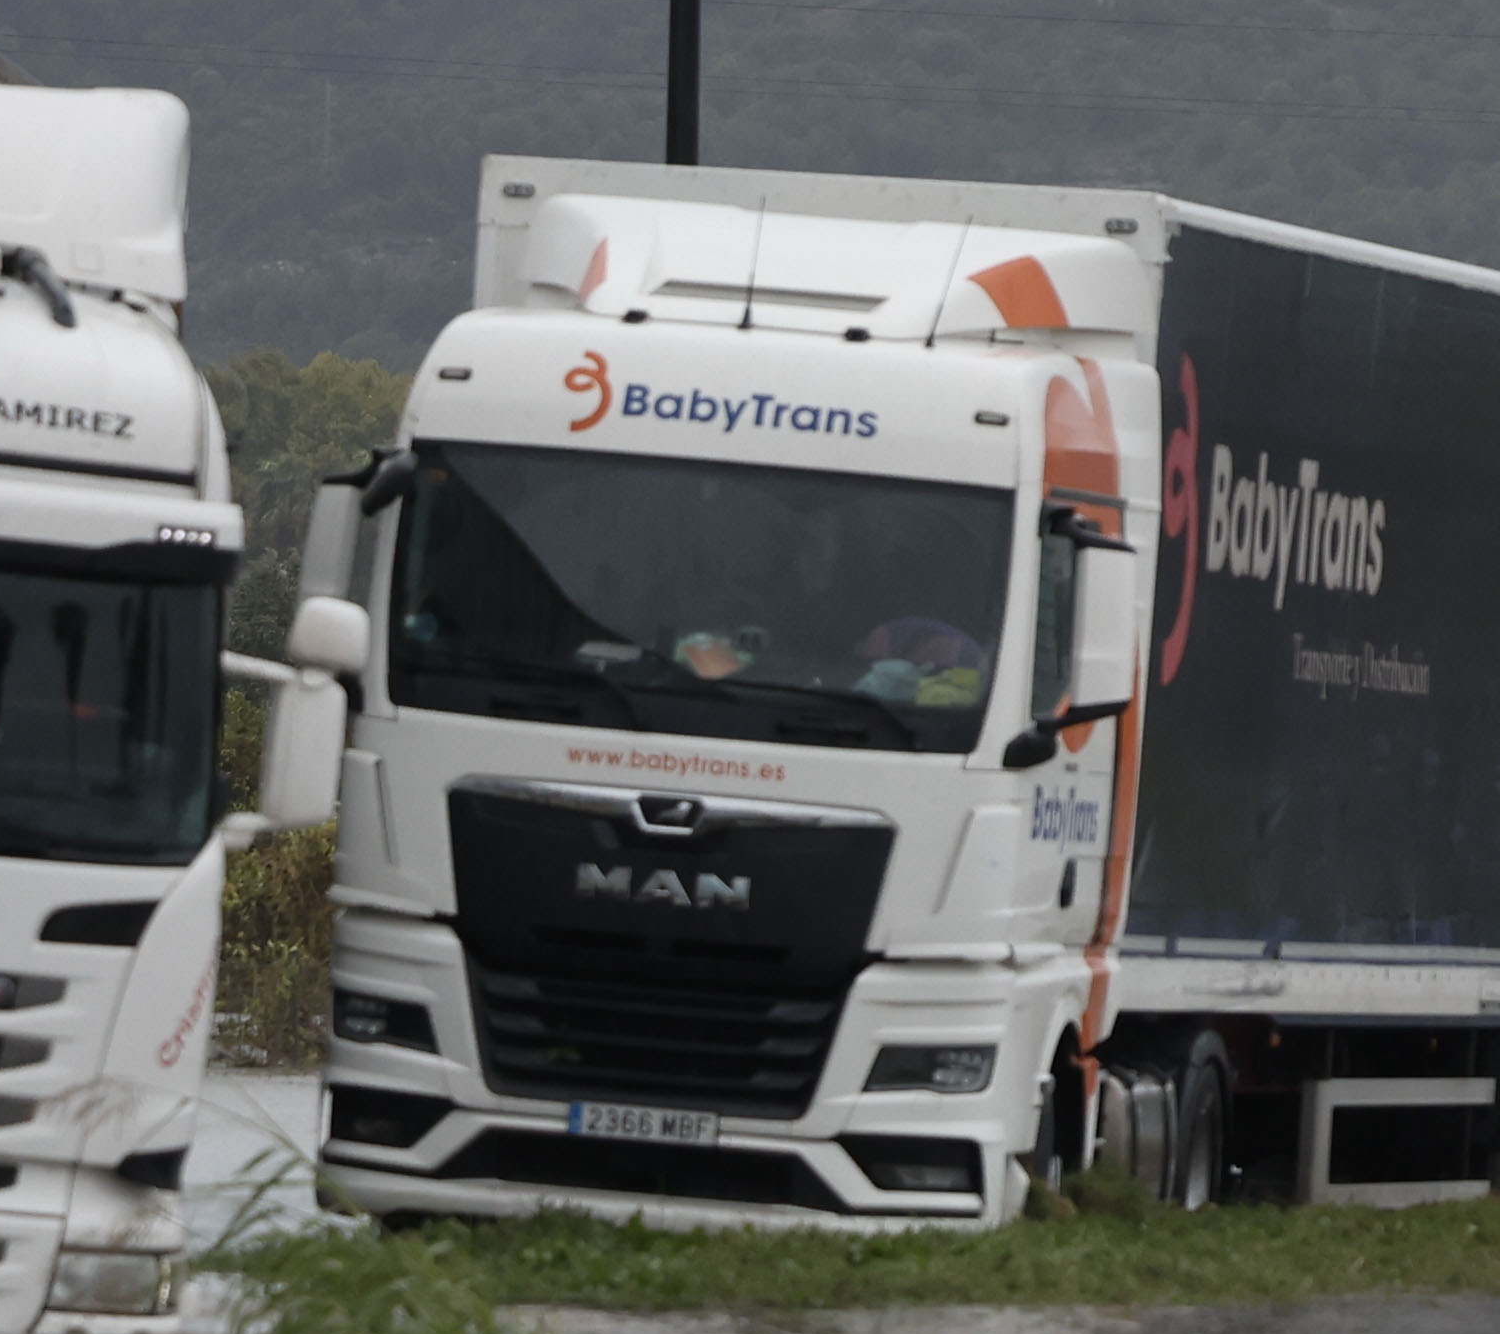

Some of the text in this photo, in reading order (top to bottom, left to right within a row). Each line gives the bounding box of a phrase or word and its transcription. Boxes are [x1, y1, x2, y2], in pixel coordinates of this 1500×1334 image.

[621, 382, 879, 438] BabyTrans
[1206, 443, 1387, 611] BabyTrans
[566, 746, 787, 782] www.babytrans.es
[1031, 783, 1098, 854] BabyTrans
[576, 863, 752, 909] MAN
[587, 1106, 653, 1134] 2366
